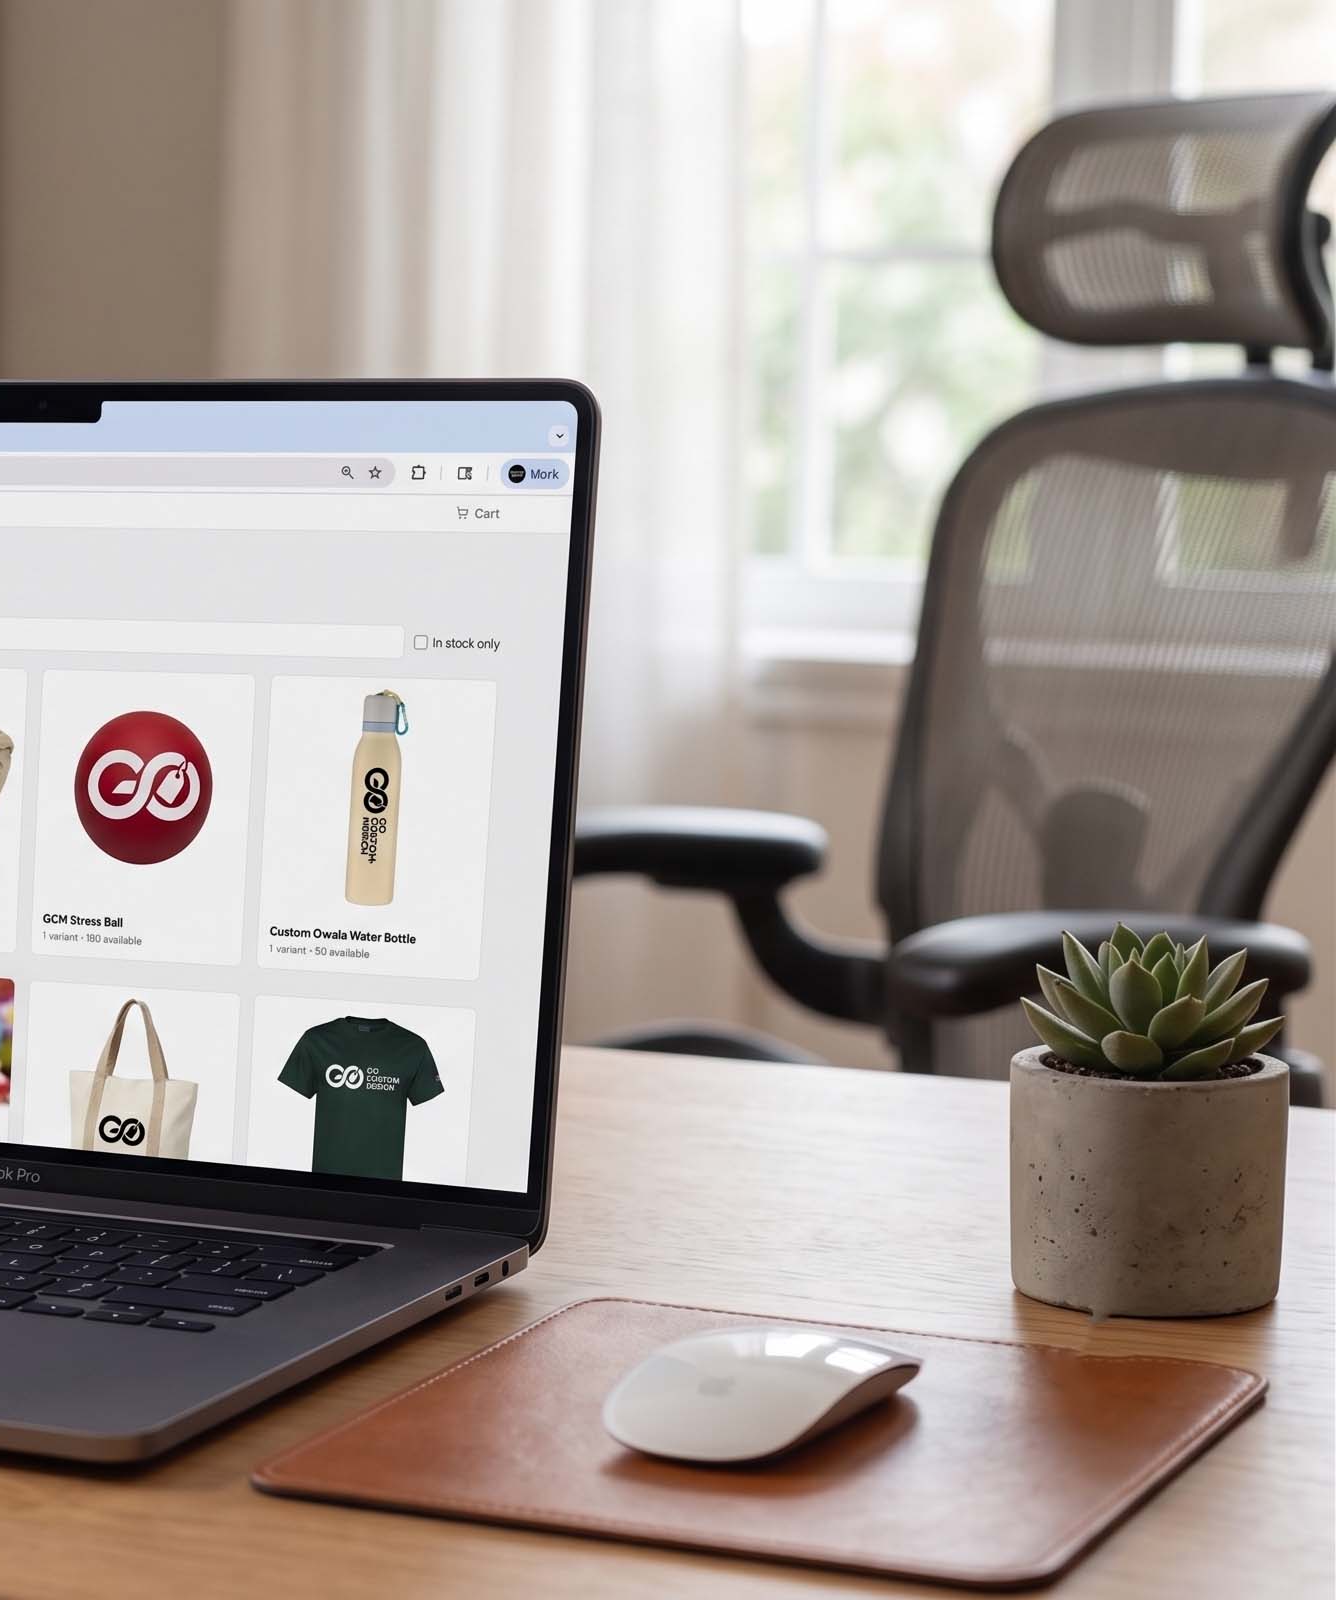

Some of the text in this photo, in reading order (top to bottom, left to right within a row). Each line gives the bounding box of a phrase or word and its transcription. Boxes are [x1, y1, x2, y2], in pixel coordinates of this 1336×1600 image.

[531, 469, 559, 479] Mork
[475, 508, 500, 519] Cart
[433, 637, 500, 652] In stock only
[43, 914, 123, 928] GCM Stress Ball
[49, 932, 78, 941] variant
[86, 933, 101, 943] 180
[103, 936, 142, 945] available
[270, 926, 416, 944] Custom Owala Water Bottle
[276, 946, 306, 955] variant
[315, 947, 327, 956] 50
[329, 948, 370, 958] available
[17, 1168, 40, 1182] Pro
